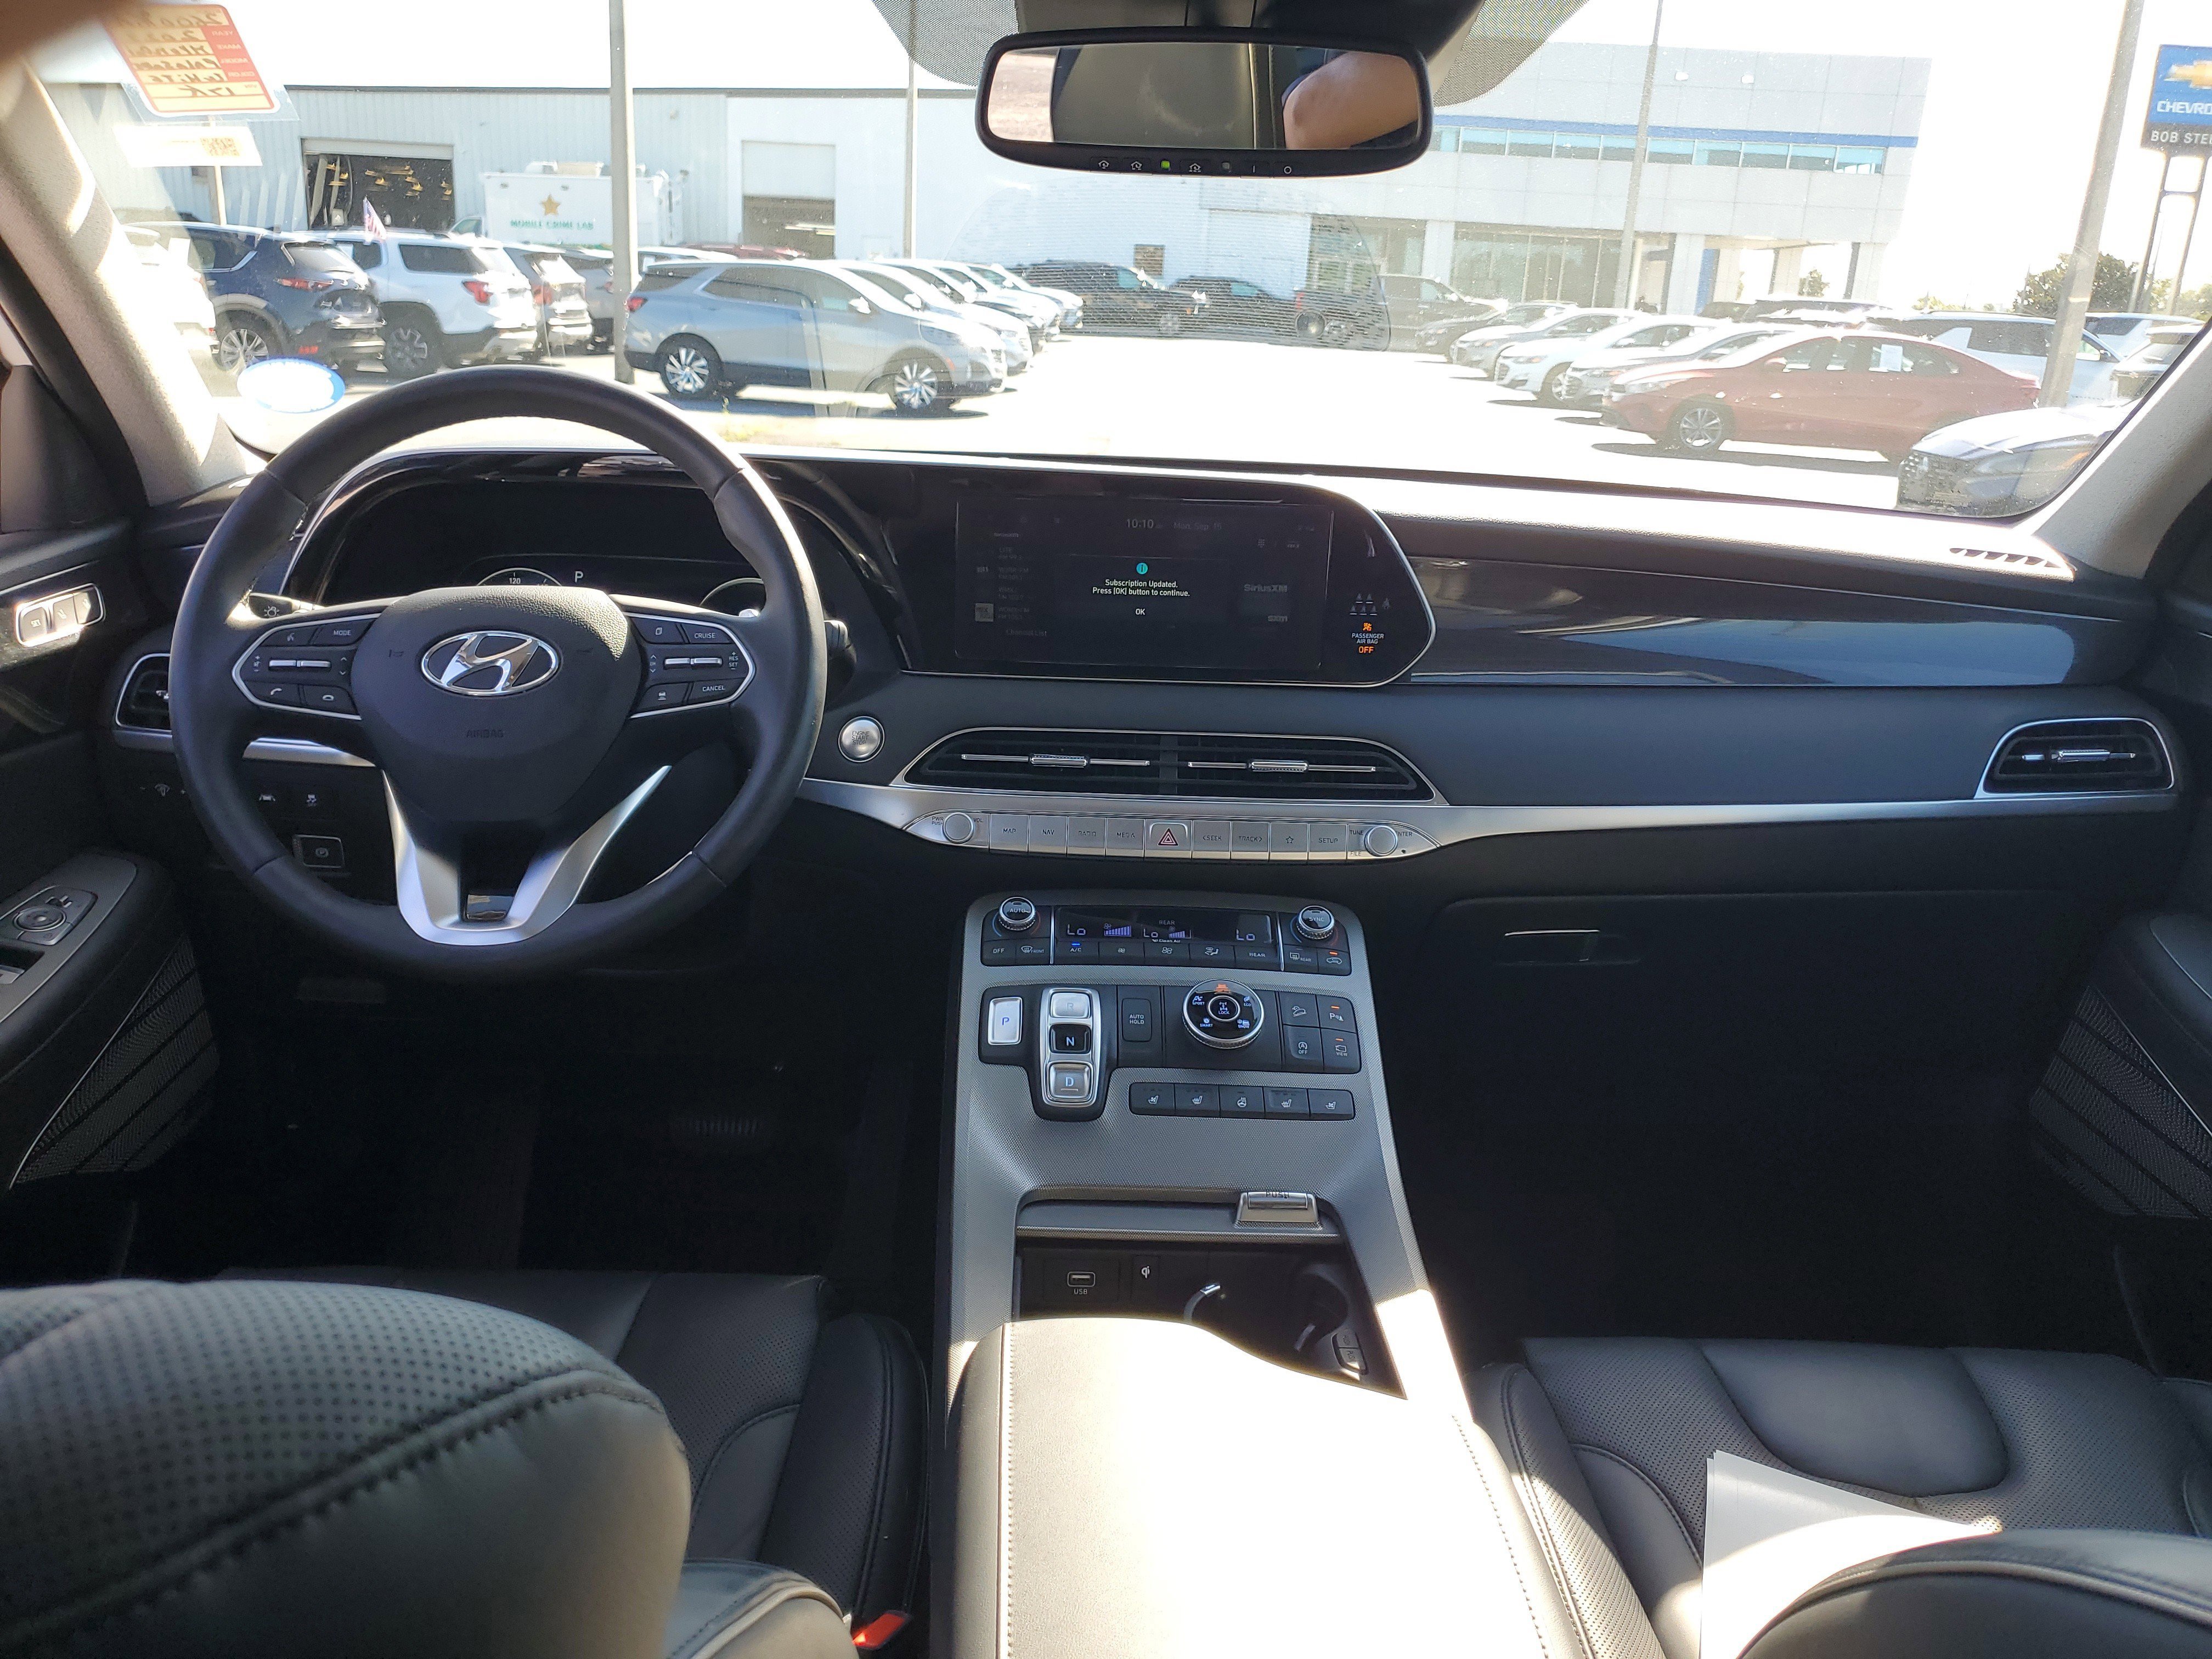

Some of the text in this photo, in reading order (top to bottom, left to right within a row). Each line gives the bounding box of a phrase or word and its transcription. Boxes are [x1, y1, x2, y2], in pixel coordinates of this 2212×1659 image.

[2151, 130, 2179, 143] BOB
[1126, 518, 1154, 529] 10:10
[574, 571, 583, 582] P
[1104, 579, 1178, 589] Subscription Updated.
[1113, 588, 1127, 596] [OK]
[1358, 646, 1374, 654] OFF
[465, 729, 505, 738] AIRBAG
[1001, 1017, 1009, 1026] P
[1066, 1036, 1075, 1046] N
[1065, 1076, 1074, 1087] D
